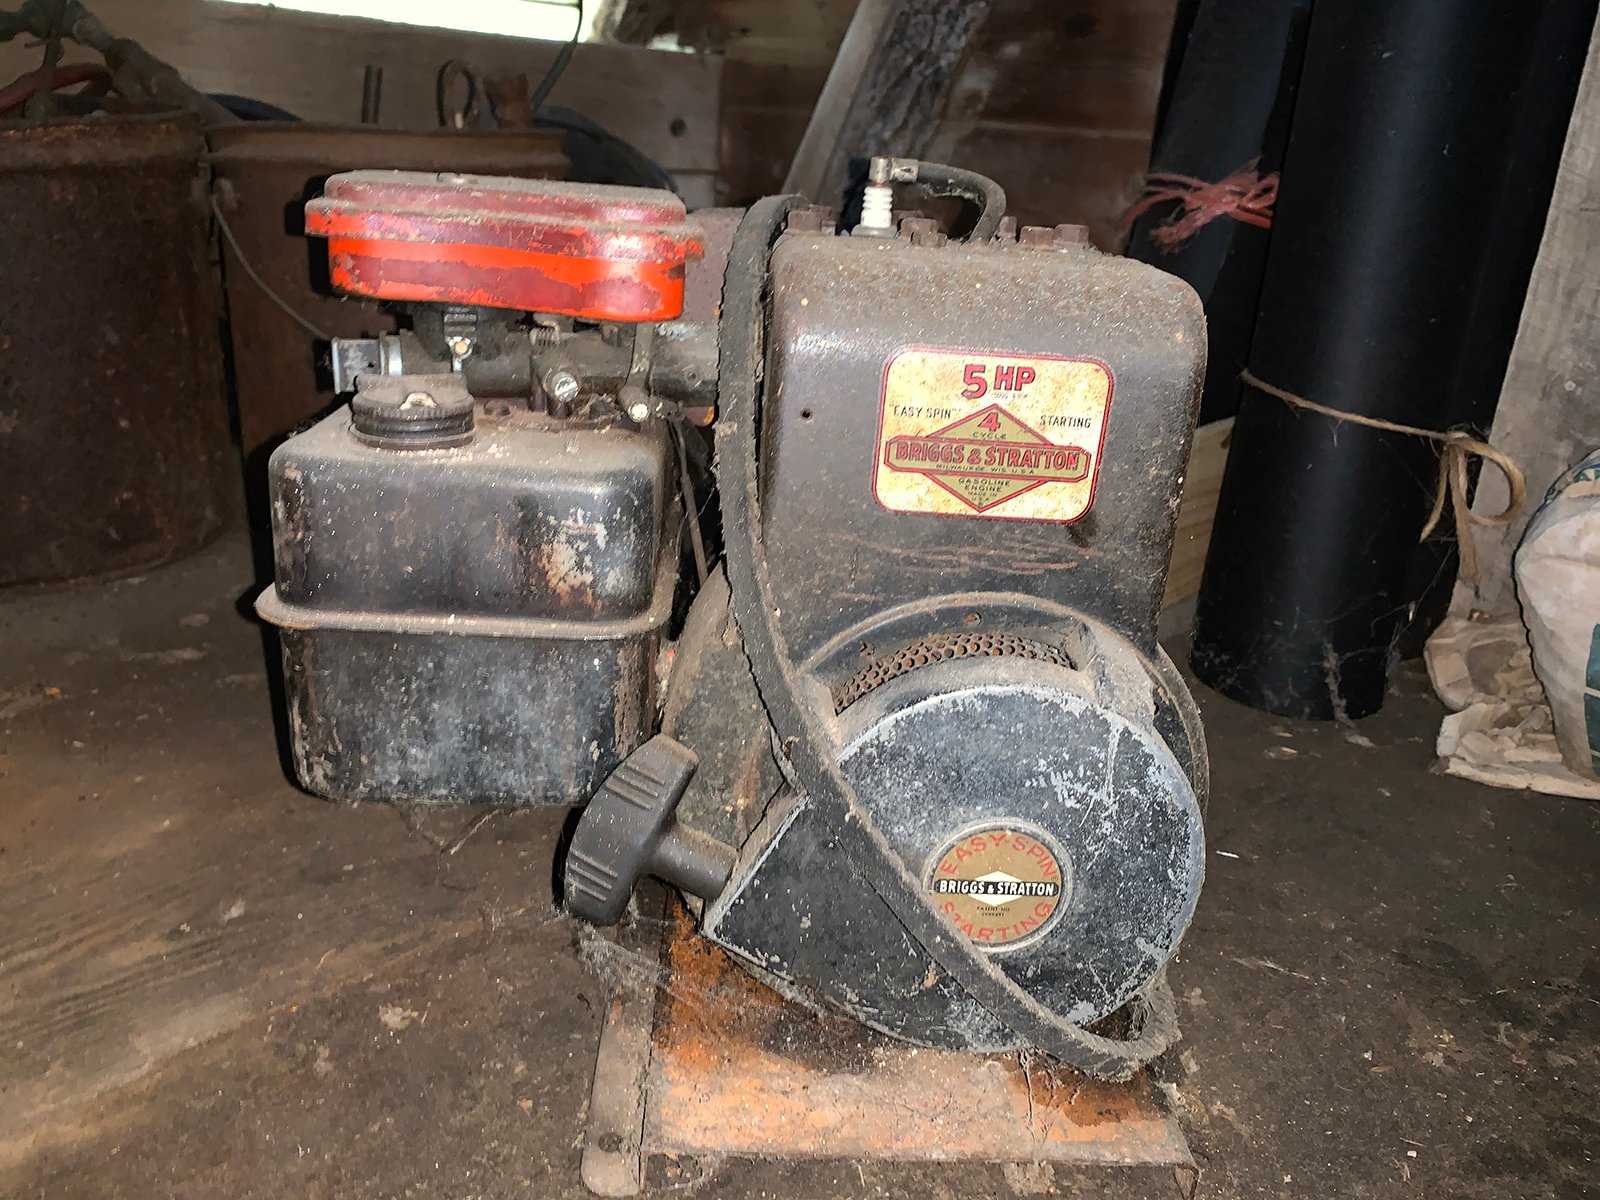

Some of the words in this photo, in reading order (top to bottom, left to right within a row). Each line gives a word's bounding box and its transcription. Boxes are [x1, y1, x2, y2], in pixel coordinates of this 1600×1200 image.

[961, 364, 988, 400] 5
[993, 365, 1036, 391] HP
[977, 411, 1001, 432] 4
[1040, 415, 1092, 429] STARTING
[972, 431, 1007, 440] CYCLE
[896, 441, 964, 464] BRIGGS
[966, 447, 982, 465] &
[984, 446, 1080, 471] STRATTON
[958, 477, 1011, 486] GASOLINE
[964, 485, 1002, 493] ENGINE
[940, 880, 985, 895] BRIGGS
[987, 885, 995, 894] &
[997, 882, 1055, 896] STRATTON
